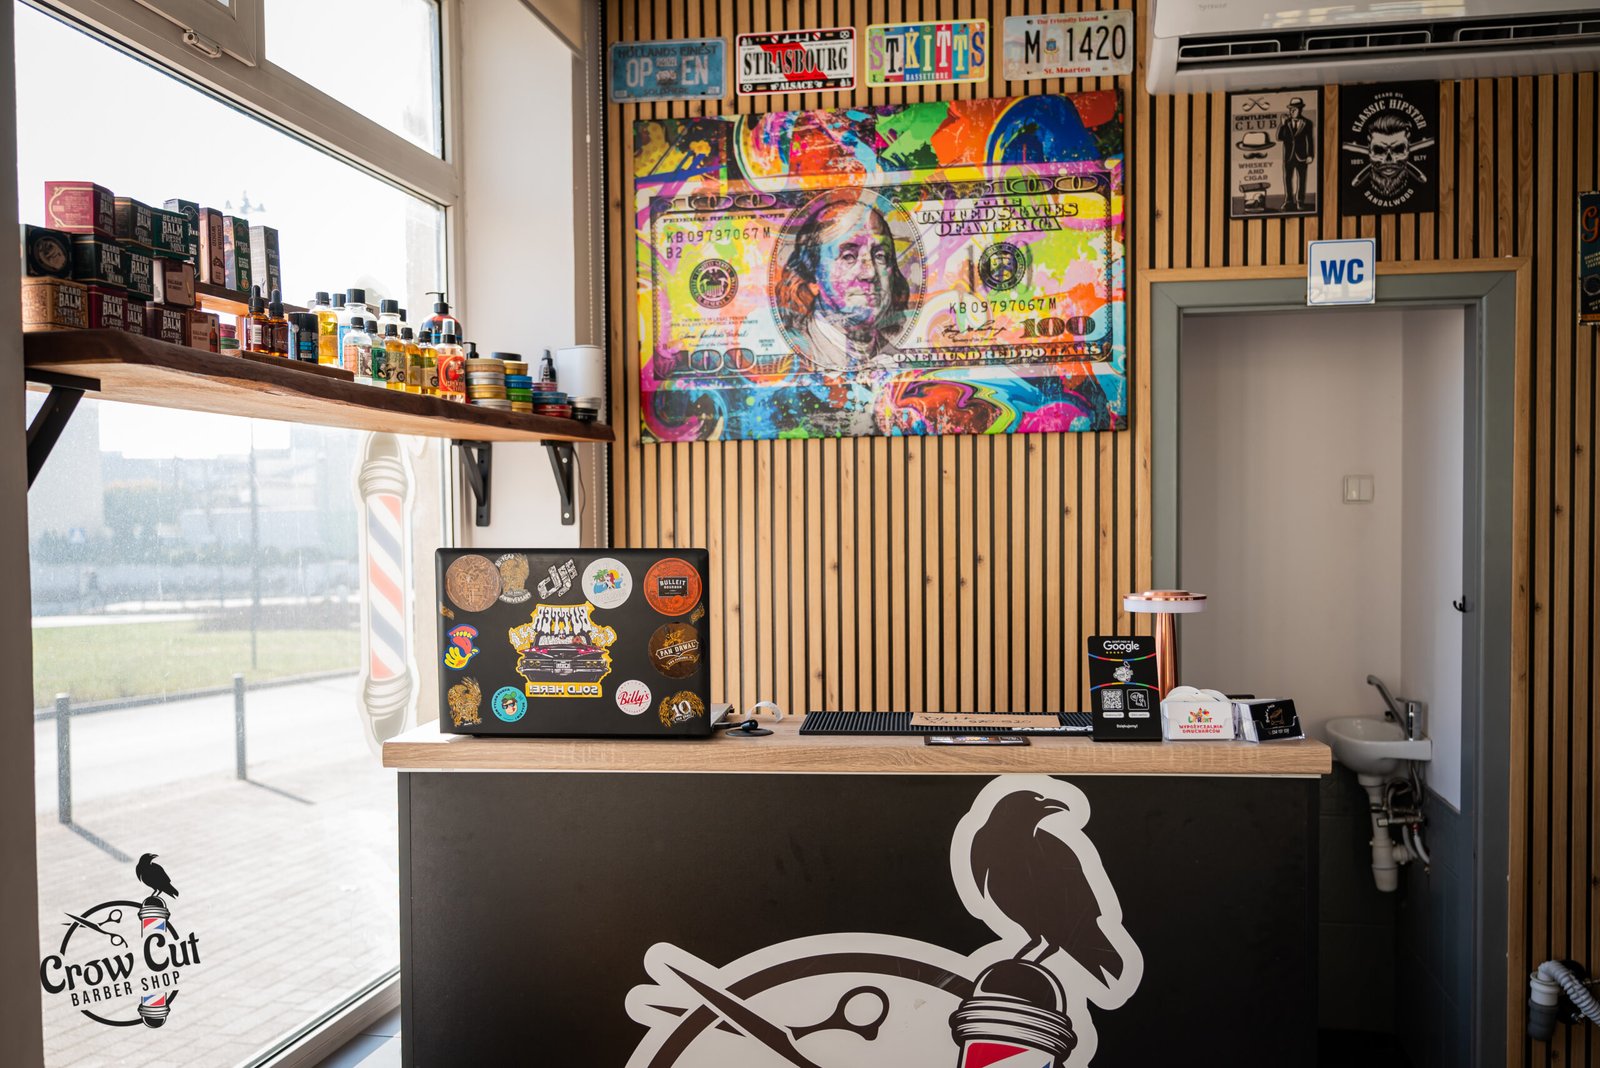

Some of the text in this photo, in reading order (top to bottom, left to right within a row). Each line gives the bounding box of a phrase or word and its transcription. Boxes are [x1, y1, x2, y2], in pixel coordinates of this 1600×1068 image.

[1050, 17, 1077, 25] Friendly
[618, 45, 718, 58] HOLLANDS FINEST
[1024, 24, 1126, 65] M 1420
[743, 46, 848, 76] STRASBOURG
[626, 55, 709, 88] OP EN
[1056, 66, 1091, 74] Maarten
[779, 80, 814, 91] ALSACE
[1374, 92, 1393, 100] BEARD
[1235, 113, 1277, 122] GENTLEMEN
[1352, 98, 1427, 133] CLASSIC HIPSTER
[1235, 120, 1277, 131] CLUB
[1239, 161, 1274, 169] WHISKEY
[1363, 187, 1415, 208] SANDALWOOD
[162, 214, 182, 225] BEARD
[917, 202, 1078, 224] UNITED STATES
[162, 221, 183, 238] BALM
[963, 217, 1062, 235] AMERICA
[102, 243, 120, 254] BEARD
[666, 246, 683, 260] B2
[102, 250, 120, 268] BALM
[132, 254, 150, 264] BEARD
[131, 260, 149, 278] BALM
[1320, 258, 1364, 285] WC
[60, 285, 81, 296] BEARD
[103, 294, 123, 304] BEARD
[59, 293, 81, 311] BALM
[103, 302, 123, 319] BALM
[163, 310, 181, 319] BEARD
[162, 316, 181, 333] BALM
[1019, 315, 1096, 339] 100
[893, 345, 1102, 363] ONE HUNDRED DOLLARS
[659, 648, 673, 657] PAN
[1103, 640, 1140, 653] Google
[617, 689, 650, 707] Billy's
[671, 700, 691, 717] 10
